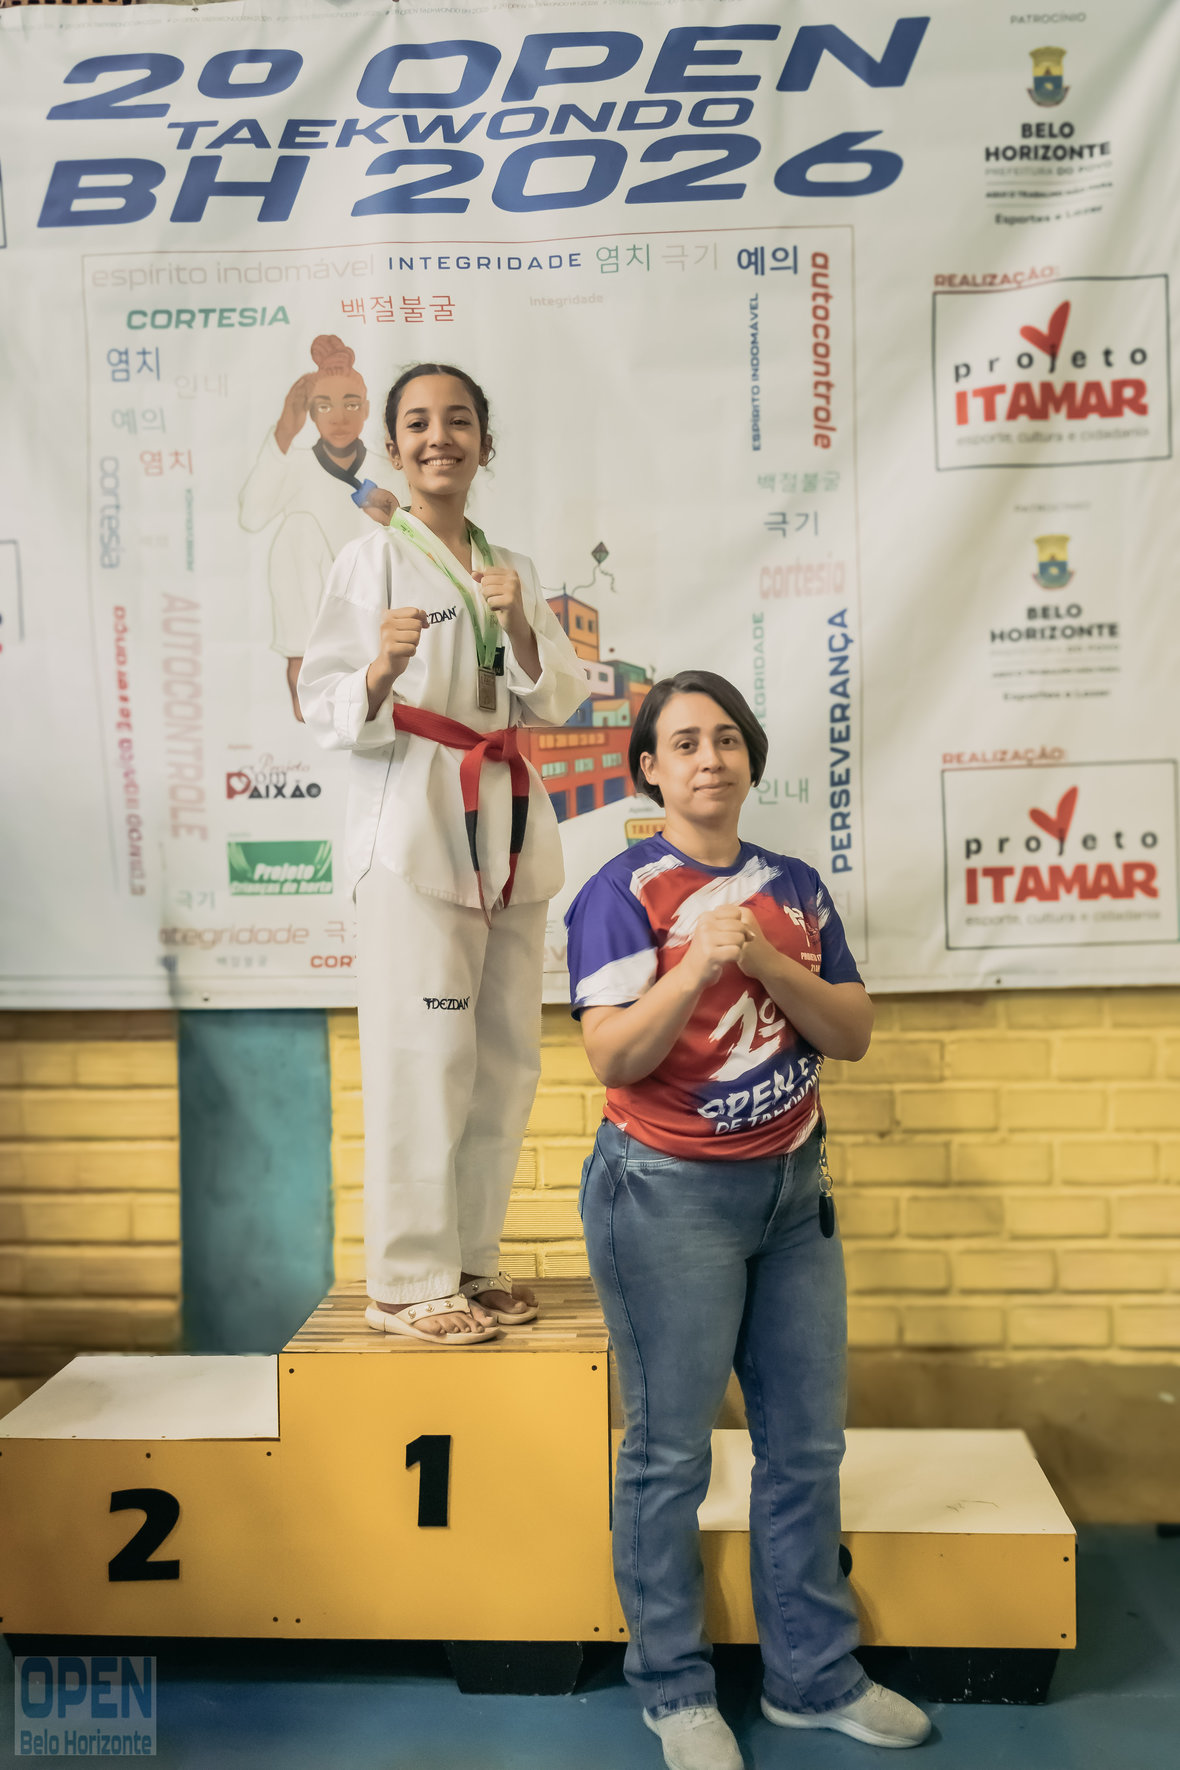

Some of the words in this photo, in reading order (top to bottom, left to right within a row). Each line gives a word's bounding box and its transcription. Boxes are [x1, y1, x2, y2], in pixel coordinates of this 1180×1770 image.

[357, 17, 931, 108] OPEN
[167, 97, 754, 150] TAEKWONDO
[1021, 122, 1075, 139] BELO
[985, 141, 1111, 162] HORIZONTE
[37, 155, 310, 228] BH
[351, 130, 904, 217] 2026
[92, 261, 208, 292] espírito
[216, 254, 374, 285] indomável
[388, 253, 582, 270] INTEGRIDADE
[596, 243, 651, 274] 염치
[661, 242, 718, 272] 극기
[737, 245, 799, 276] 예의
[126, 306, 290, 330] CORTESIA
[341, 295, 456, 325] 백절불굴
[747, 292, 760, 381] INDOMÁVEL
[811, 252, 837, 450] autocontrole
[106, 346, 162, 383] 염치
[955, 345, 1147, 383] projeto
[750, 385, 762, 452] ESPÍRITO
[955, 378, 1149, 426] ITAMAR
[139, 448, 194, 477] 염치
[763, 510, 819, 539] 극기
[1027, 603, 1083, 621] BELO
[991, 622, 1118, 643] HORIZONTE
[161, 591, 209, 841] AUTOCONTROLE
[827, 608, 854, 874] PERSEVERANÇA
[965, 827, 1158, 860] projeto
[966, 861, 1159, 905] ITAMAR
[697, 1064, 794, 1119] OPEN
[715, 1119, 742, 1135] DE
[405, 1435, 451, 1528] 1
[108, 1488, 180, 1582] 2
